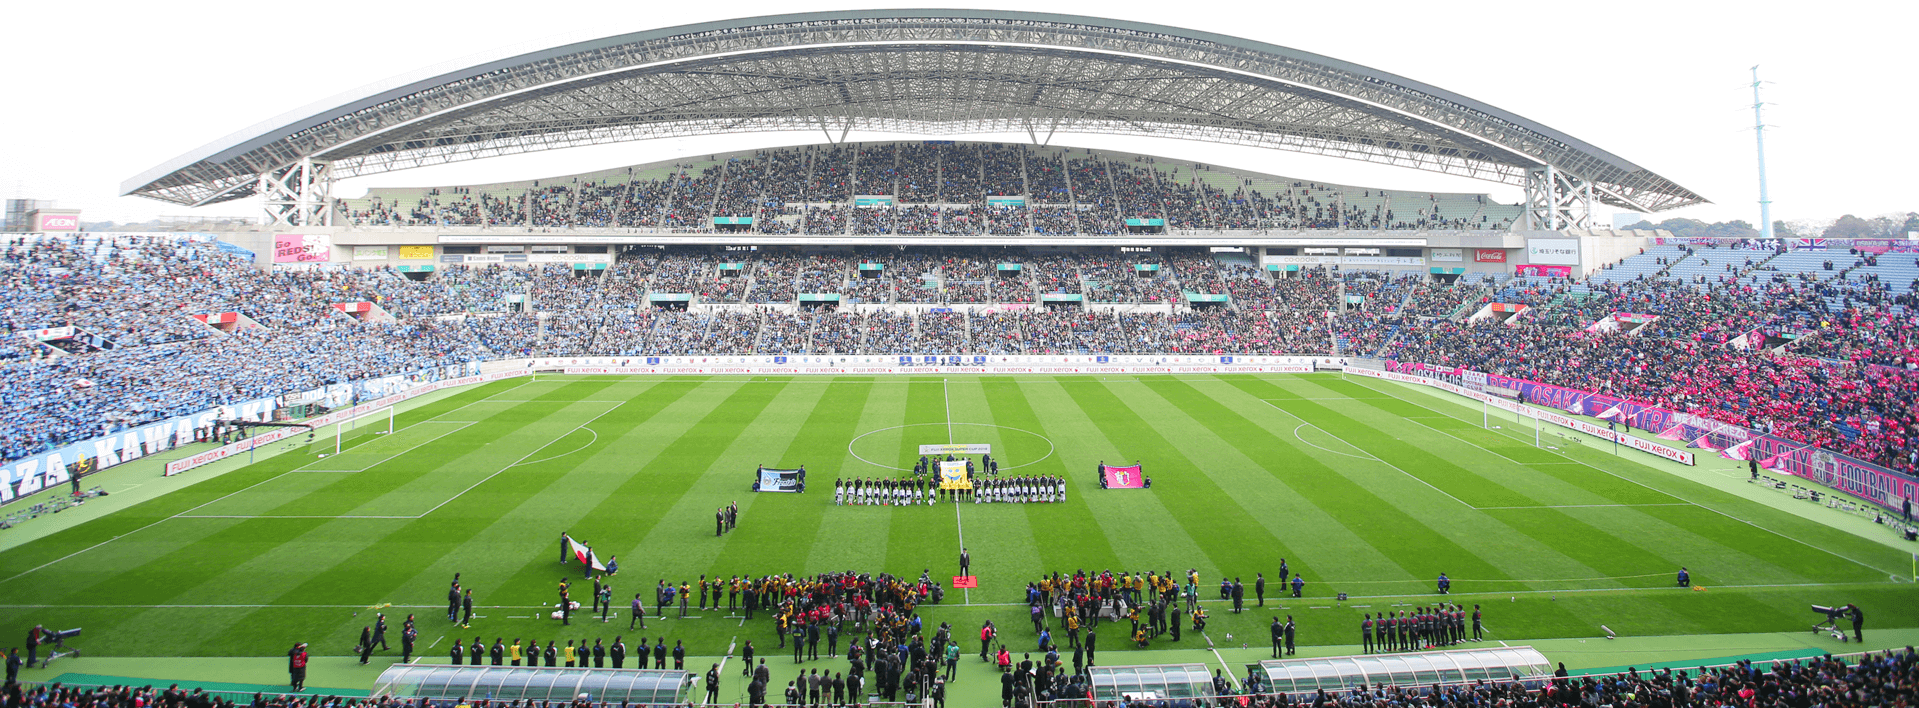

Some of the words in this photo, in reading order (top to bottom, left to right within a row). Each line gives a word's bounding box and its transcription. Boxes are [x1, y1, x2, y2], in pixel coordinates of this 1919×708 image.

[275, 241, 291, 249] Go
[278, 244, 314, 258] REDS!
[296, 252, 318, 262] Go!
[504, 370, 522, 378] xerox
[1442, 382, 1455, 391] xerox
[1474, 391, 1488, 400] xerox
[1498, 399, 1510, 408] FUJI
[1537, 410, 1550, 420] FUJI
[1550, 414, 1569, 425] xerox
[1689, 416, 1709, 430] ARE
[1582, 423, 1596, 434] FUJI
[236, 440, 252, 452] FUJI
[253, 433, 276, 445] xerox
[1634, 439, 1650, 450] FUJI
[1651, 443, 1677, 458] xerox
[172, 458, 191, 472] FUJI
[192, 451, 219, 465] xerox
[1839, 460, 1898, 506] FOOTBALL
